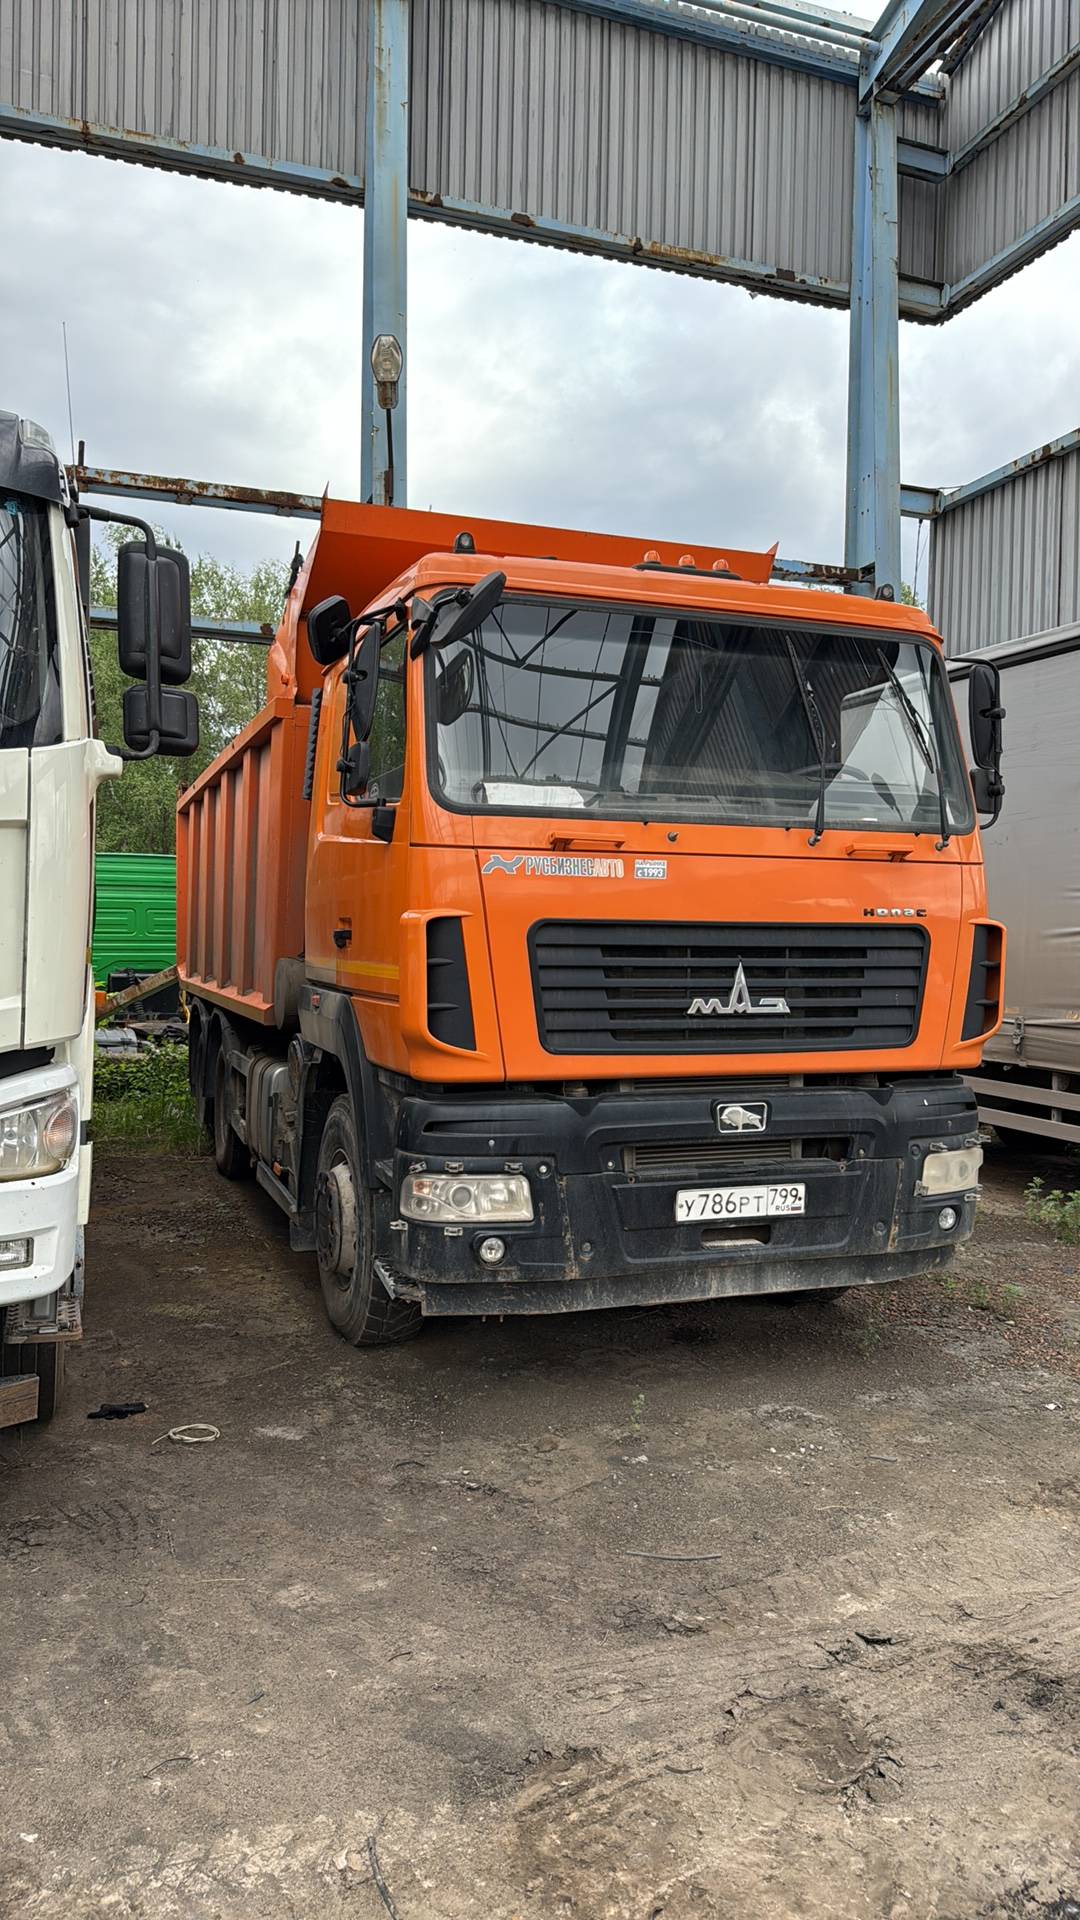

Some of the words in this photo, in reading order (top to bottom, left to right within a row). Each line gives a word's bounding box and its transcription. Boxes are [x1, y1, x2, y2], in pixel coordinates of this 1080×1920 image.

[525, 855, 624, 878] РУСБИЗНЕСАВТО
[644, 868, 663, 877] 1993
[685, 1192, 764, 1217] У786РТ
[770, 1187, 799, 1205] 799
